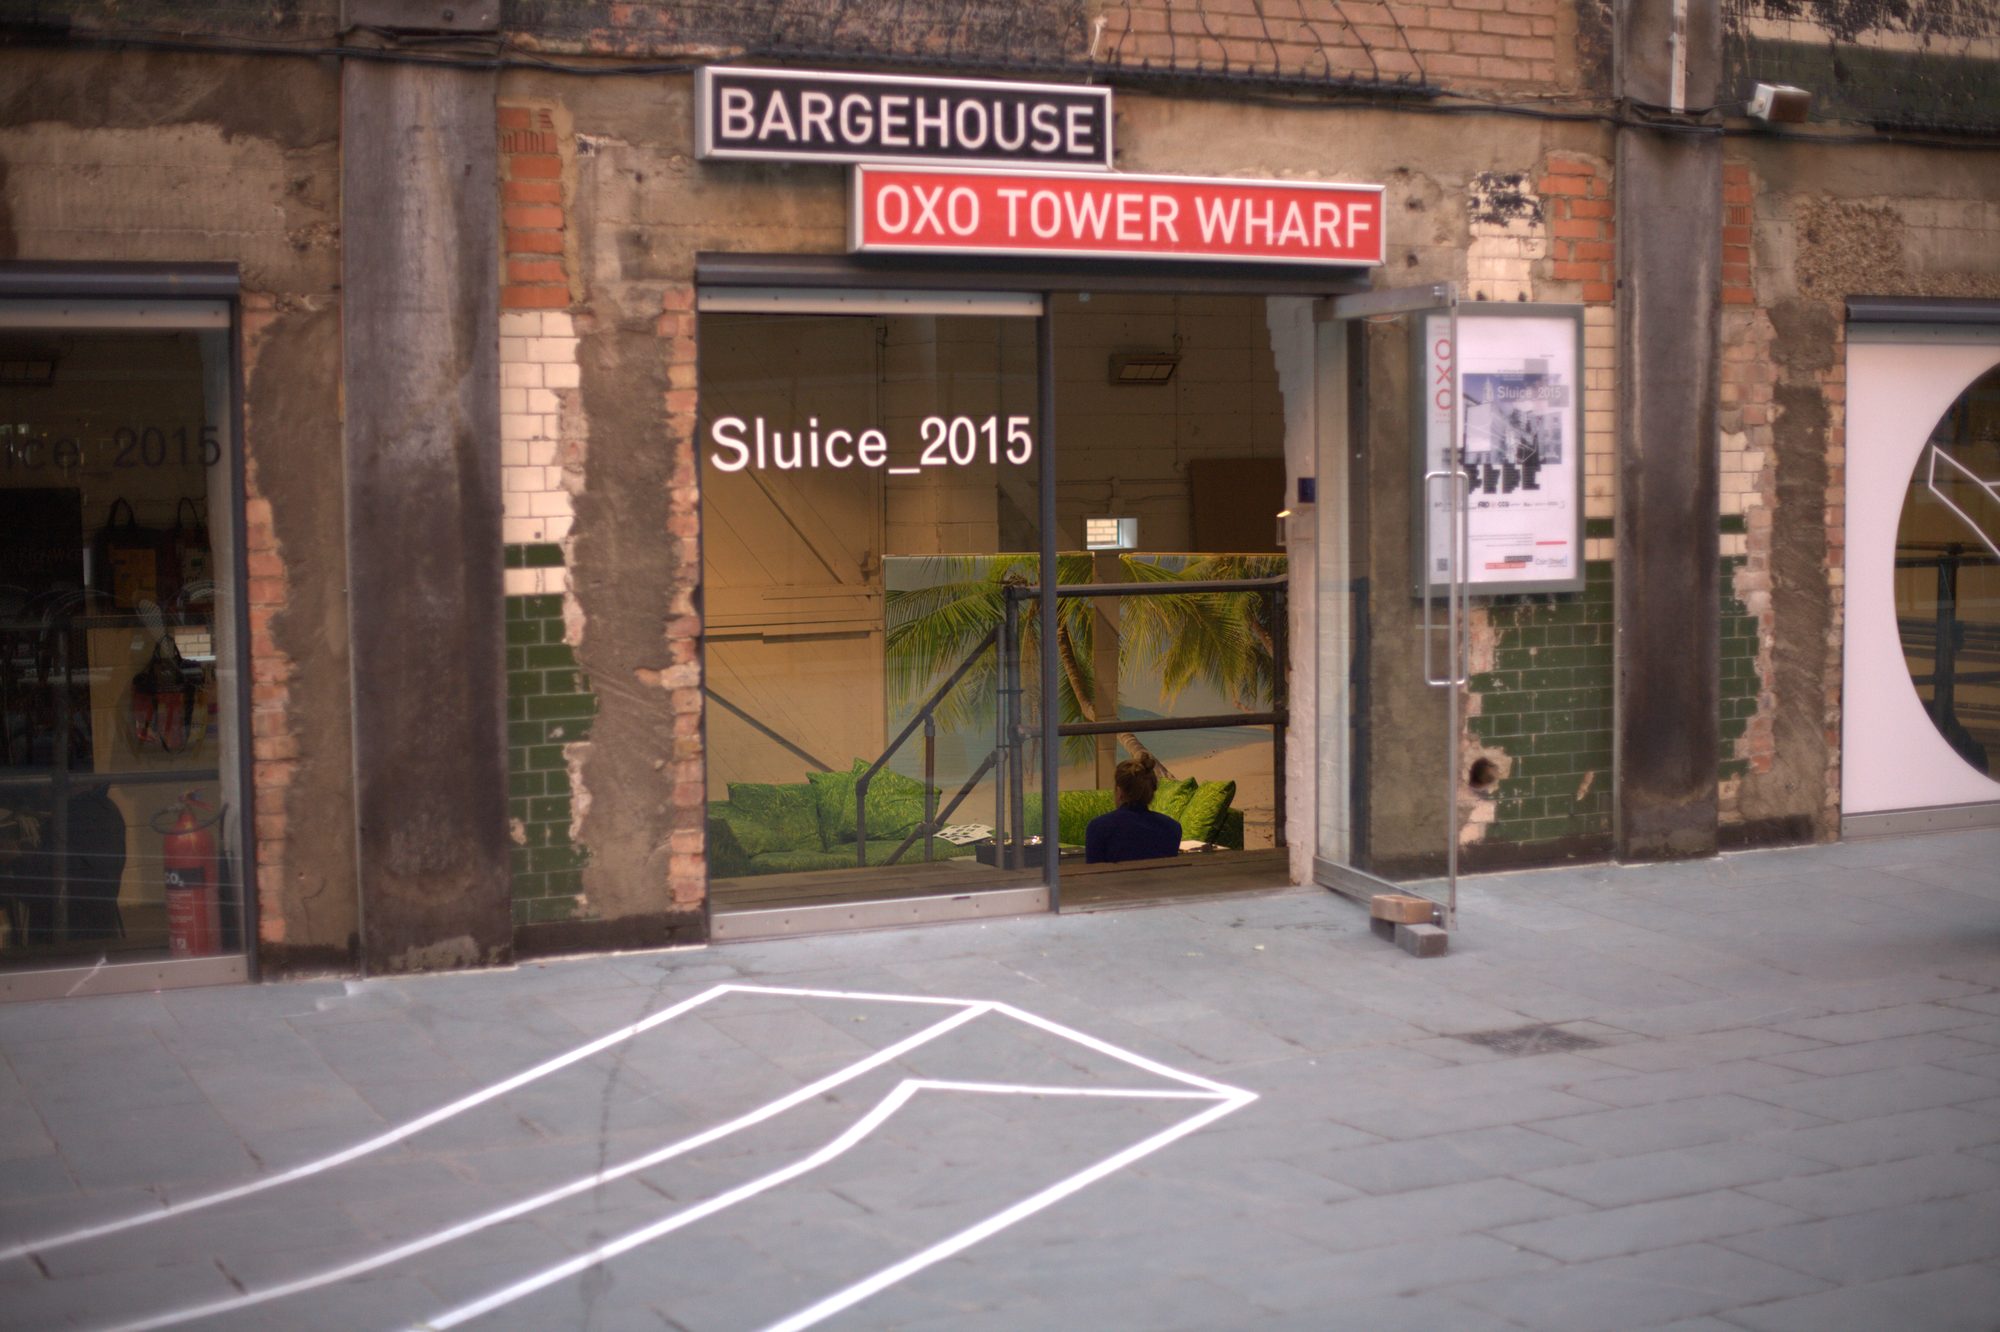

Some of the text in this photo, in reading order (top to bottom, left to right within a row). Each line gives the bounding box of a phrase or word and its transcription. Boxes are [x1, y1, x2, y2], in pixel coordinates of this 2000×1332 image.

[719, 87, 1095, 154] BARGEHOUSE
[875, 184, 1373, 249] OXO TOWER WHARF
[710, 415, 1033, 475] Sluice_2015
